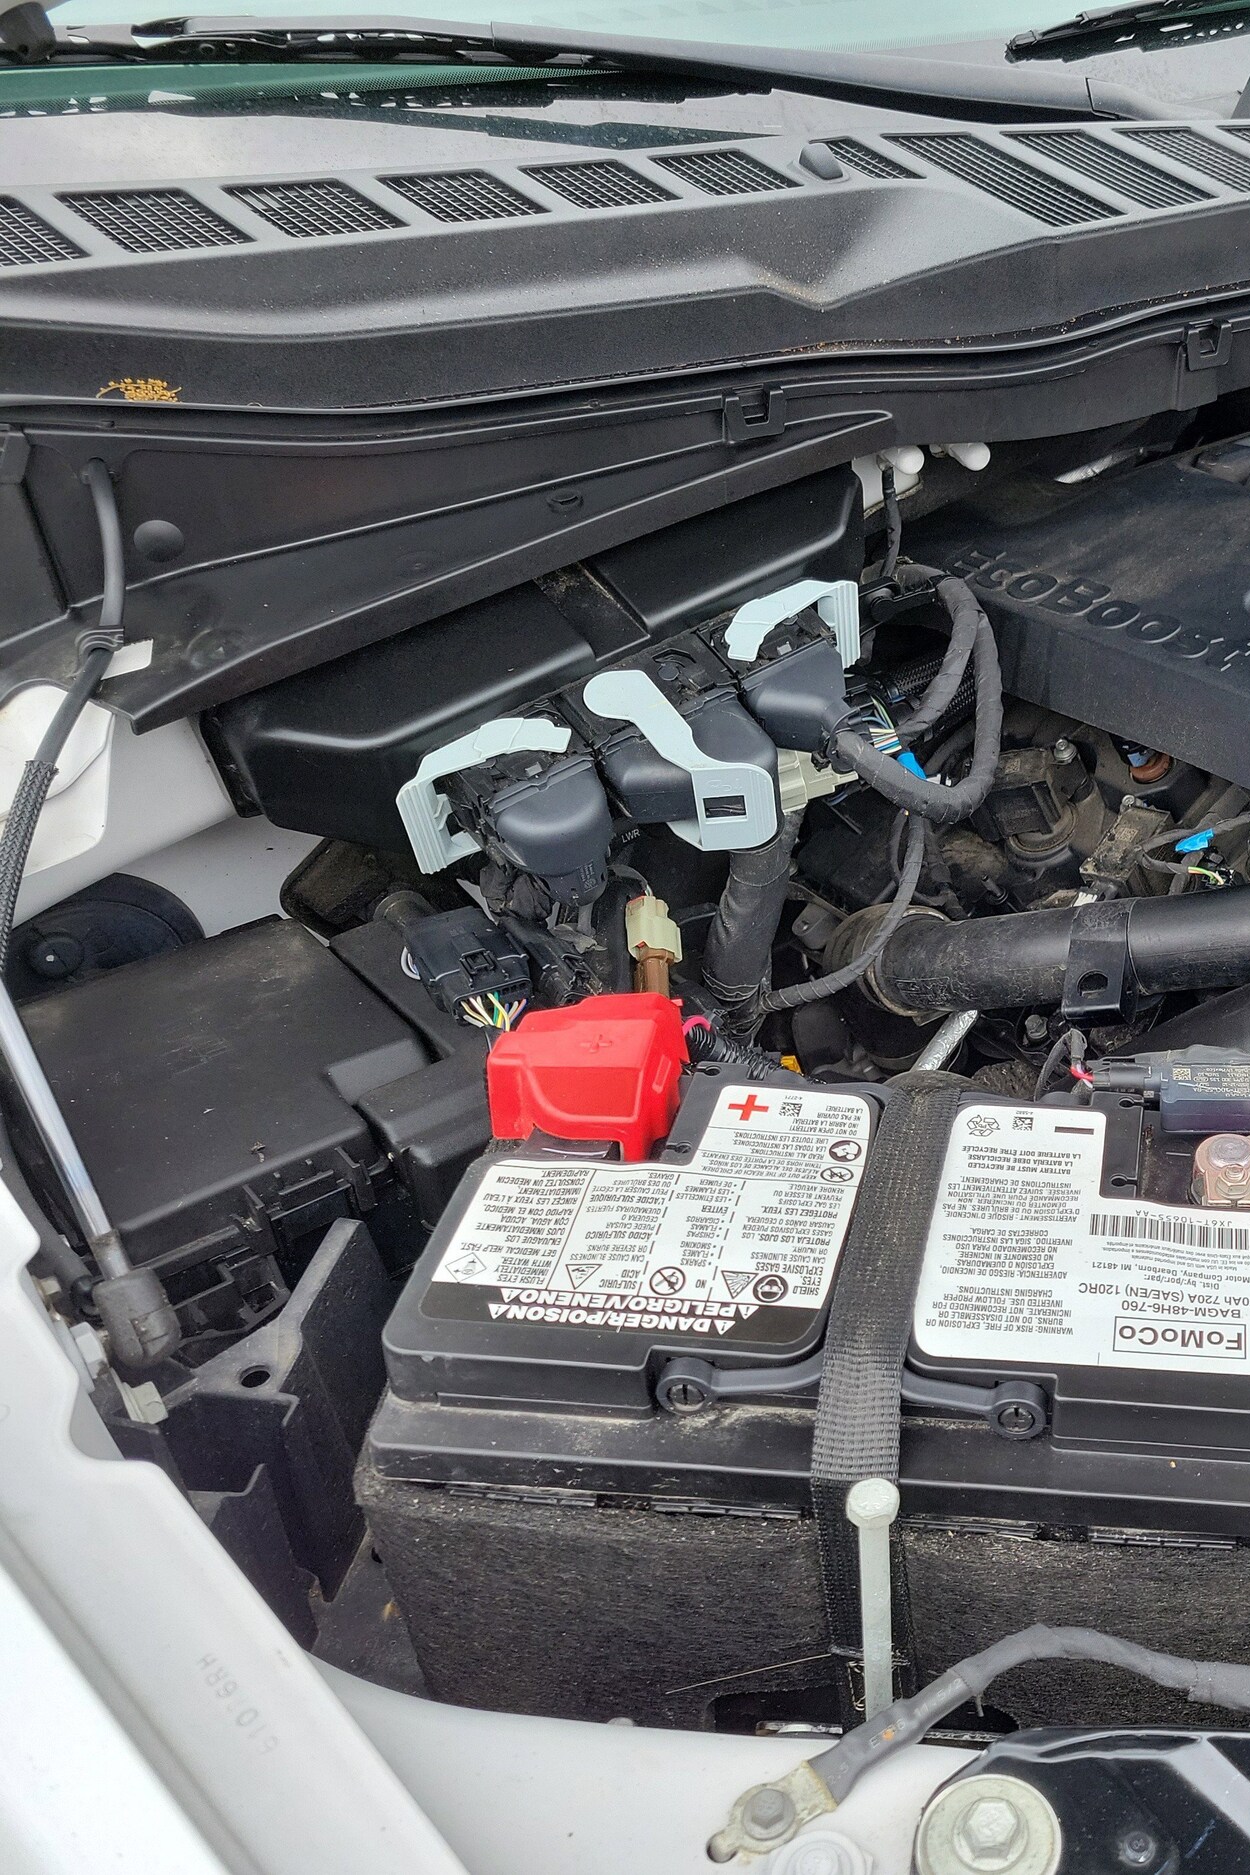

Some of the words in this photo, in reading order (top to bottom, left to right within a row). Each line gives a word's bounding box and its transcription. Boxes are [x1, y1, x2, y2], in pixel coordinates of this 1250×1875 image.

[621, 828, 640, 843] LWR
[789, 1125, 817, 1133] BATTERY!
[750, 1148, 795, 1159] INSTRUCTIONS.
[968, 1154, 1011, 1163] RECICLARSE
[1012, 1157, 1031, 1165] DEBE
[1033, 1159, 1062, 1167] BATERÍA
[968, 1162, 1004, 1171] RECYCLED
[1039, 1167, 1071, 1175] BATTERY
[700, 1179, 722, 1187] FUMER
[788, 1183, 818, 1192] AVEUGLE.
[685, 1185, 717, 1194] FLAMMES
[819, 1186, 844, 1194] RENDRE
[589, 1194, 635, 1203] SULFURIQUE
[715, 1195, 727, 1203] LES
[784, 1191, 813, 1199] BLESSER
[815, 1193, 843, 1201] PEUVENT
[778, 1198, 813, 1207] EXPLOSIFS
[761, 1206, 782, 1215] YEUX.
[785, 1208, 798, 1216] LES
[686, 1215, 720, 1224] CIGARROS
[745, 1216, 777, 1225] CEGUERA.
[779, 1218, 784, 1226] O
[743, 1224, 769, 1232] PUEDEN
[809, 1221, 835, 1229] CAUSAR
[687, 1231, 715, 1239] CHISPAS
[771, 1226, 810, 1235] EXPLOSIVOS
[812, 1229, 833, 1237] GASES
[741, 1232, 755, 1240] LOS
[758, 1233, 779, 1242] OJOS.
[781, 1235, 795, 1243] LOS
[680, 1240, 711, 1249] SMOKING
[797, 1236, 831, 1246] PROTEJA
[460, 1242, 482, 1252] FAST.
[482, 1244, 504, 1253] HELP
[505, 1246, 540, 1256] MEDICAL
[792, 1246, 817, 1254] INJURY.
[541, 1249, 557, 1257] GET
[682, 1249, 709, 1258] FLAMES
[750, 1252, 788, 1262] BLINDNESS
[501, 1256, 530, 1266] WATER.
[608, 1254, 630, 1262] CAUSE
[680, 1258, 707, 1267] SPARKS
[788, 1254, 811, 1263] CAUSE
[813, 1256, 826, 1264] CAN
[532, 1259, 552, 1268] WITH
[755, 1262, 780, 1273] GASES
[1015, 1261, 1054, 1270] EXPLOSIÓN
[1092, 1261, 1119, 1270] 48121
[1121, 1263, 1132, 1271] MI
[493, 1265, 549, 1276] IMMEDIATELY
[621, 1269, 641, 1279] ACID
[783, 1264, 824, 1276] EXPLOSIVE
[989, 1269, 1015, 1277] RIESGO
[1135, 1264, 1177, 1277] Dearborn,
[497, 1274, 518, 1283] EYES
[519, 1276, 545, 1285] FLUSH
[1180, 1270, 1223, 1282] Company,
[1225, 1275, 1250, 1284] Motor
[599, 1279, 637, 1290] SULFURIC
[695, 1279, 707, 1288] NO
[800, 1276, 821, 1286] EYES.
[1200, 1281, 1219, 1290] Dist.
[792, 1286, 819, 1296] SHIELD
[956, 1285, 1013, 1295] INSTRUCTIONS.
[1078, 1282, 1121, 1295] 120RC
[943, 1294, 973, 1302] PROPER
[1015, 1289, 1053, 1298] CHARGING
[1125, 1284, 1184, 1303] (SAE/EN)
[517, 1289, 738, 1318] PELIGRO/VENENO
[975, 1296, 1006, 1304] FOLLOW
[1028, 1299, 1063, 1308] INVERTED
[1188, 1294, 1220, 1305] 720A
[932, 1301, 947, 1309] FOR
[950, 1303, 1007, 1313] RECOMMENDED
[1121, 1300, 1241, 1319] BAGM-48H6-760
[938, 1310, 949, 1318] OR
[951, 1311, 1003, 1321] DISASSEMBLE
[1027, 1308, 1072, 1317] INCINERATE.
[507, 1305, 712, 1332] DANGER/POISON
[926, 1319, 937, 1327] OR
[1004, 1315, 1020, 1323] NOT
[1037, 1317, 1063, 1325] BURNS.
[939, 1320, 980, 1329] EXPLOSION
[983, 1322, 1001, 1331] FIRE,
[1035, 1326, 1073, 1335] WARNING:
[1119, 1325, 1243, 1351] FoMoCo
